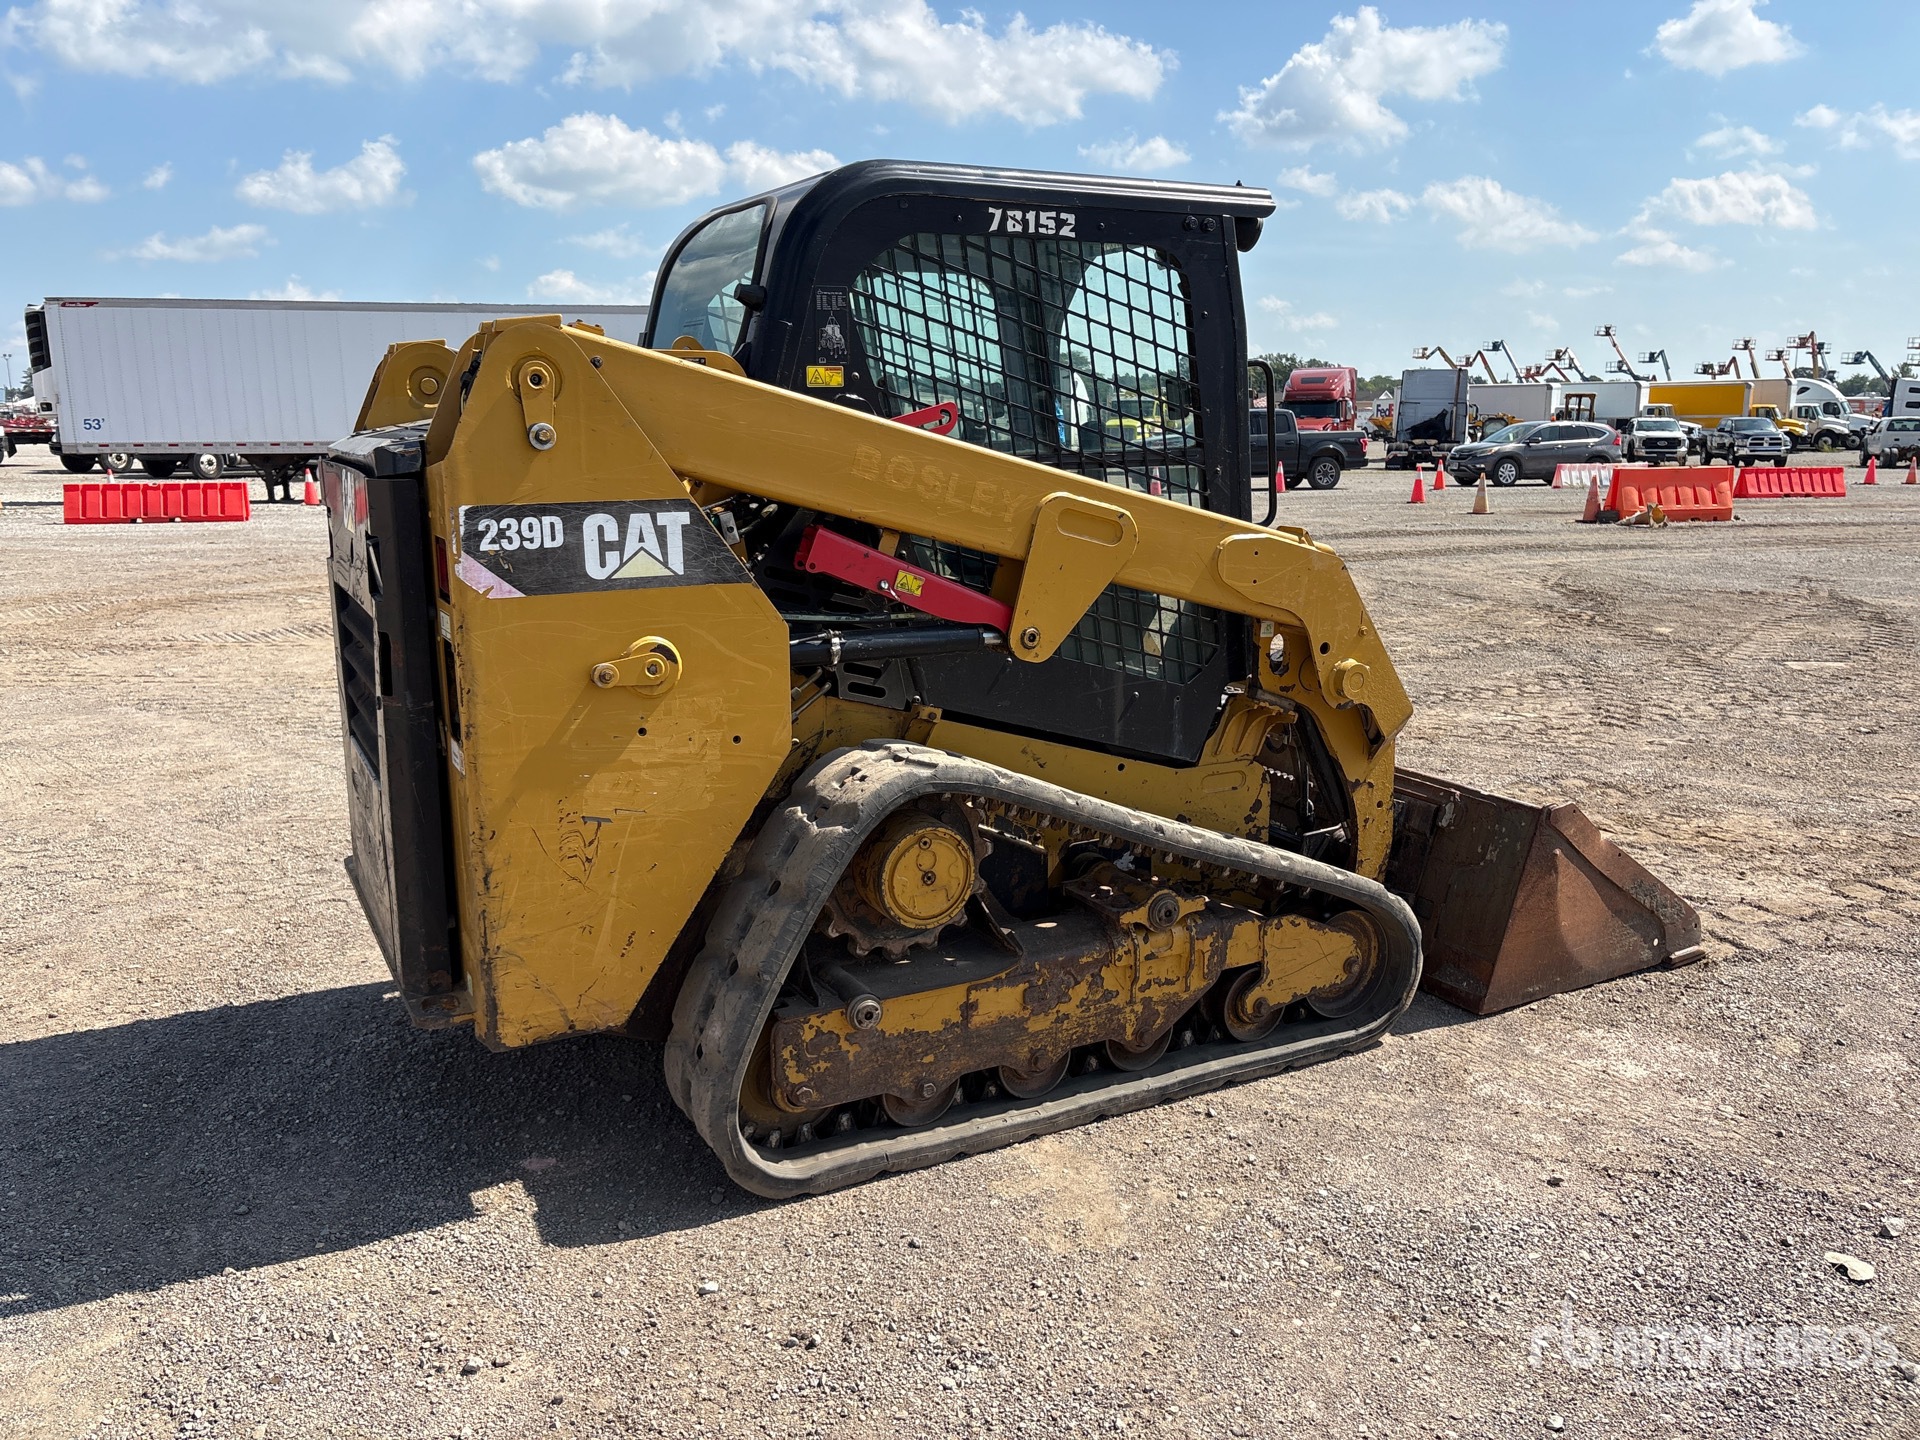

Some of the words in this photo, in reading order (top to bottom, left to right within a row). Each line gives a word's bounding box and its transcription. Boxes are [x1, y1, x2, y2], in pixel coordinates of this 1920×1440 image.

[988, 206, 1076, 238] 78152
[1376, 403, 1394, 417] FedE
[850, 443, 1027, 523] BOSLEY
[477, 515, 564, 552] 239D
[582, 511, 690, 581] CAT
